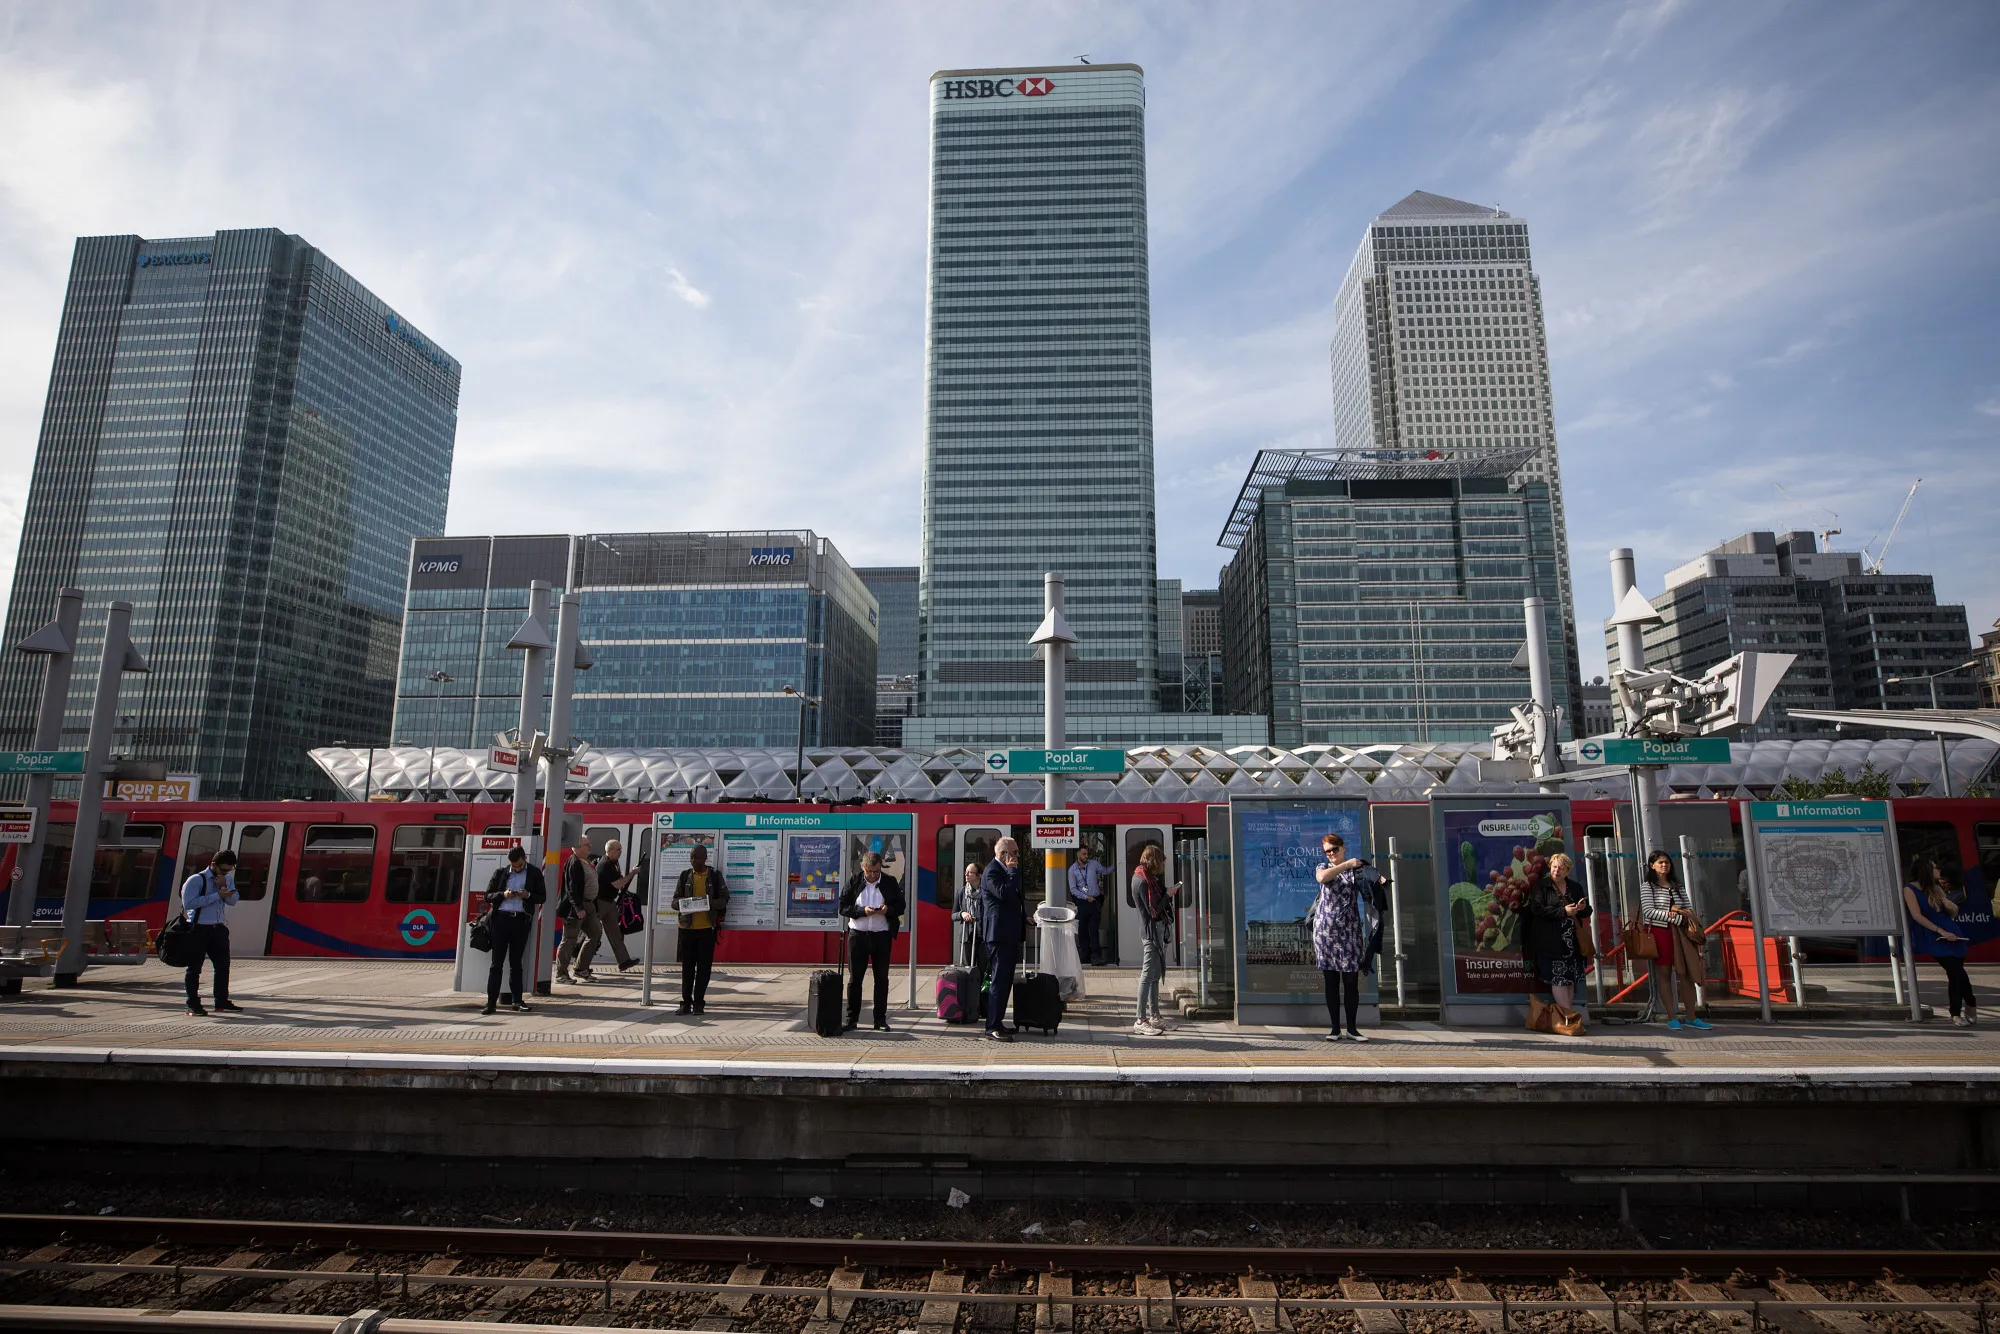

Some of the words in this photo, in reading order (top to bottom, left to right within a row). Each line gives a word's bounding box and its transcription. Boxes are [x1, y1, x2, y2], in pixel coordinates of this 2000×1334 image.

[943, 79, 1014, 99] HSBC
[151, 252, 210, 266] BARCLAYS
[748, 554, 790, 565] KPMG
[417, 561, 459, 573] KPMG
[1642, 741, 1690, 755] Poplar
[16, 754, 54, 766] Poplar
[1045, 752, 1088, 765] Poplar
[117, 783, 155, 795] YOUR
[158, 784, 186, 795] FAV
[1792, 805, 1861, 816] Information
[760, 816, 820, 825] Information
[1480, 823, 1540, 832] INSUREANDGO
[1262, 846, 1323, 857] WELCOME
